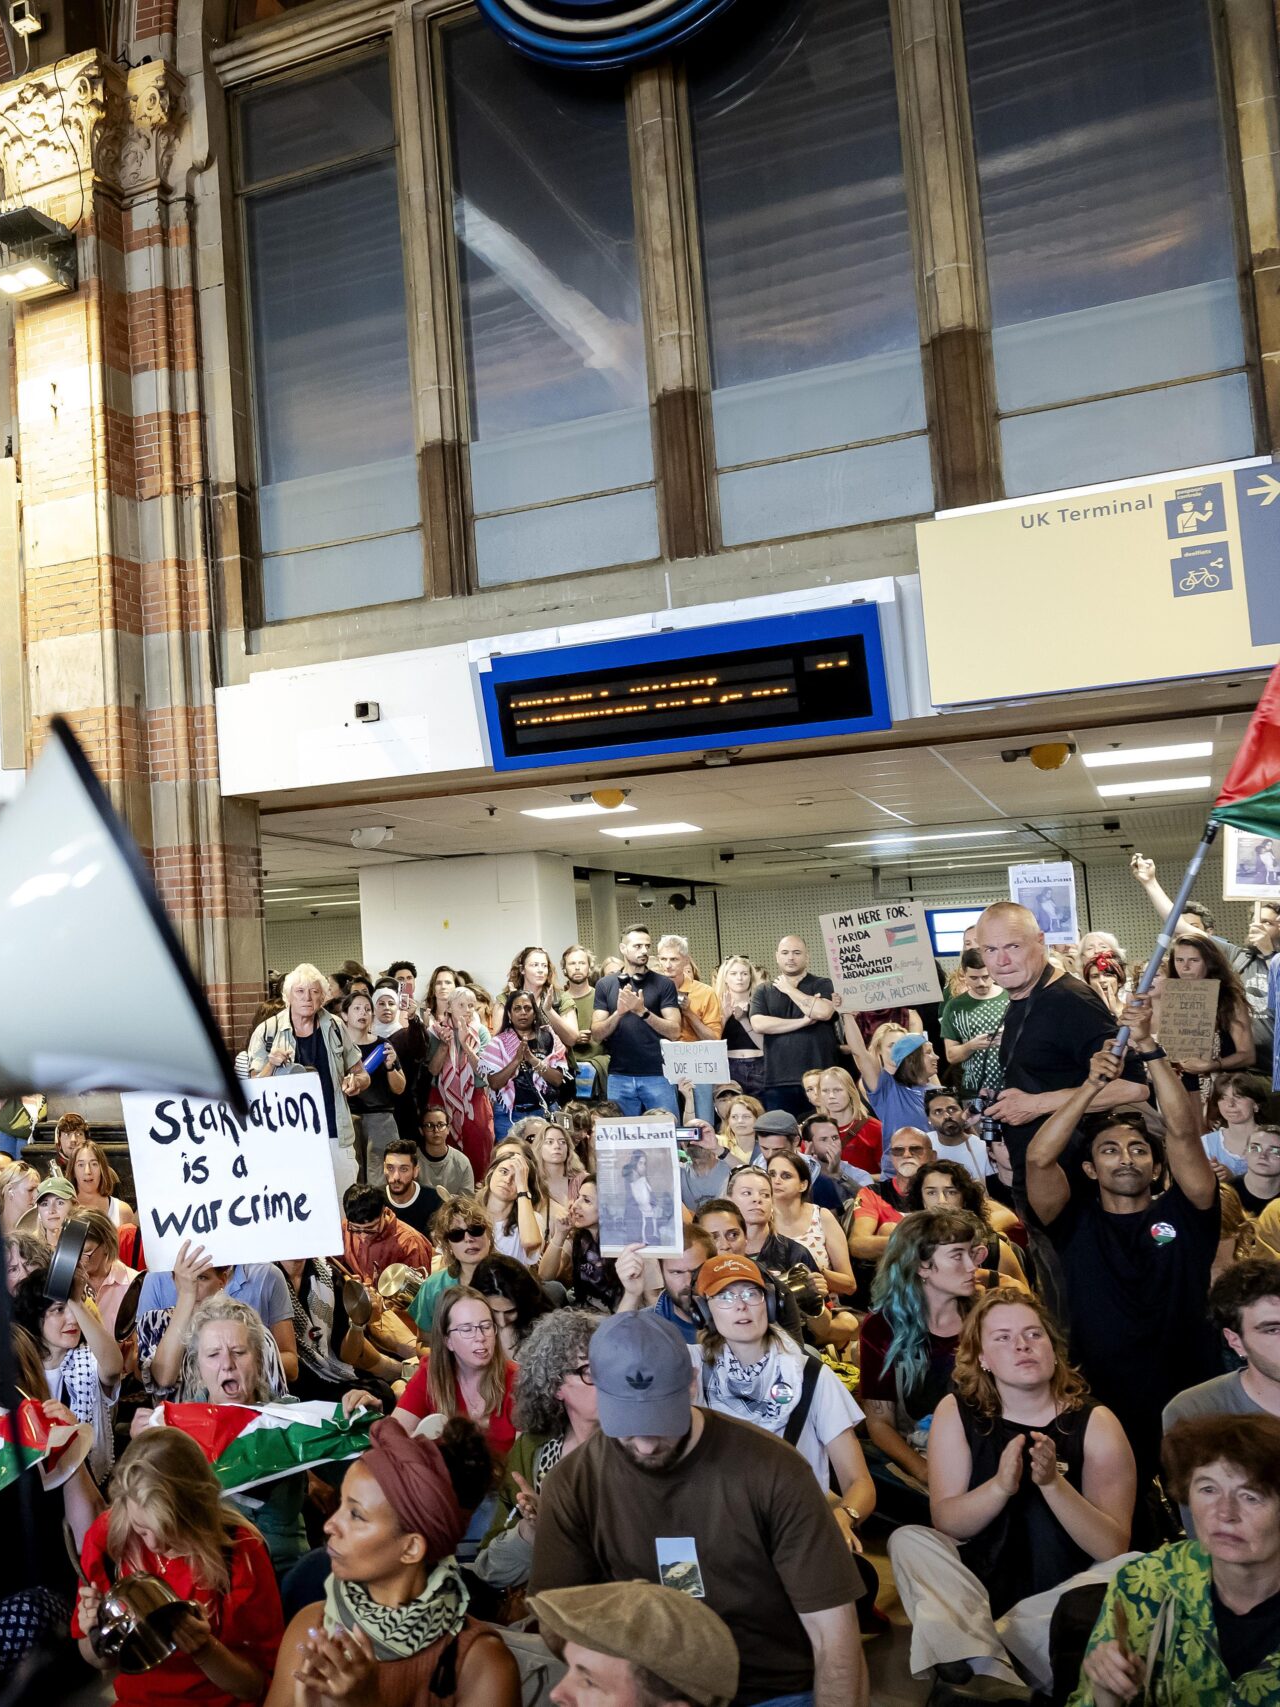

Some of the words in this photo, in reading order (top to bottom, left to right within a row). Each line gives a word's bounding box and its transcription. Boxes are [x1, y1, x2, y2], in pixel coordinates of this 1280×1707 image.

[1020, 512, 1050, 529] UK
[1057, 494, 1153, 523] Terminal
[832, 918, 837, 930] I
[838, 914, 854, 928] AM
[857, 909, 882, 926] HERE
[886, 905, 913, 920] FOR:
[837, 930, 871, 945] FARIDA
[839, 944, 861, 955] ANAS
[839, 953, 865, 966] SARA
[841, 956, 893, 972] MOHAMMED
[842, 965, 893, 980] ABDALKARIM
[842, 986, 857, 996] AND
[890, 983, 931, 1000] PALESTINE
[1180, 1002, 1206, 1010] DEATH
[674, 1044, 710, 1056] EUROPA
[674, 1062, 688, 1074] DOE
[181, 1152, 209, 1184] is
[232, 1154, 248, 1178] a
